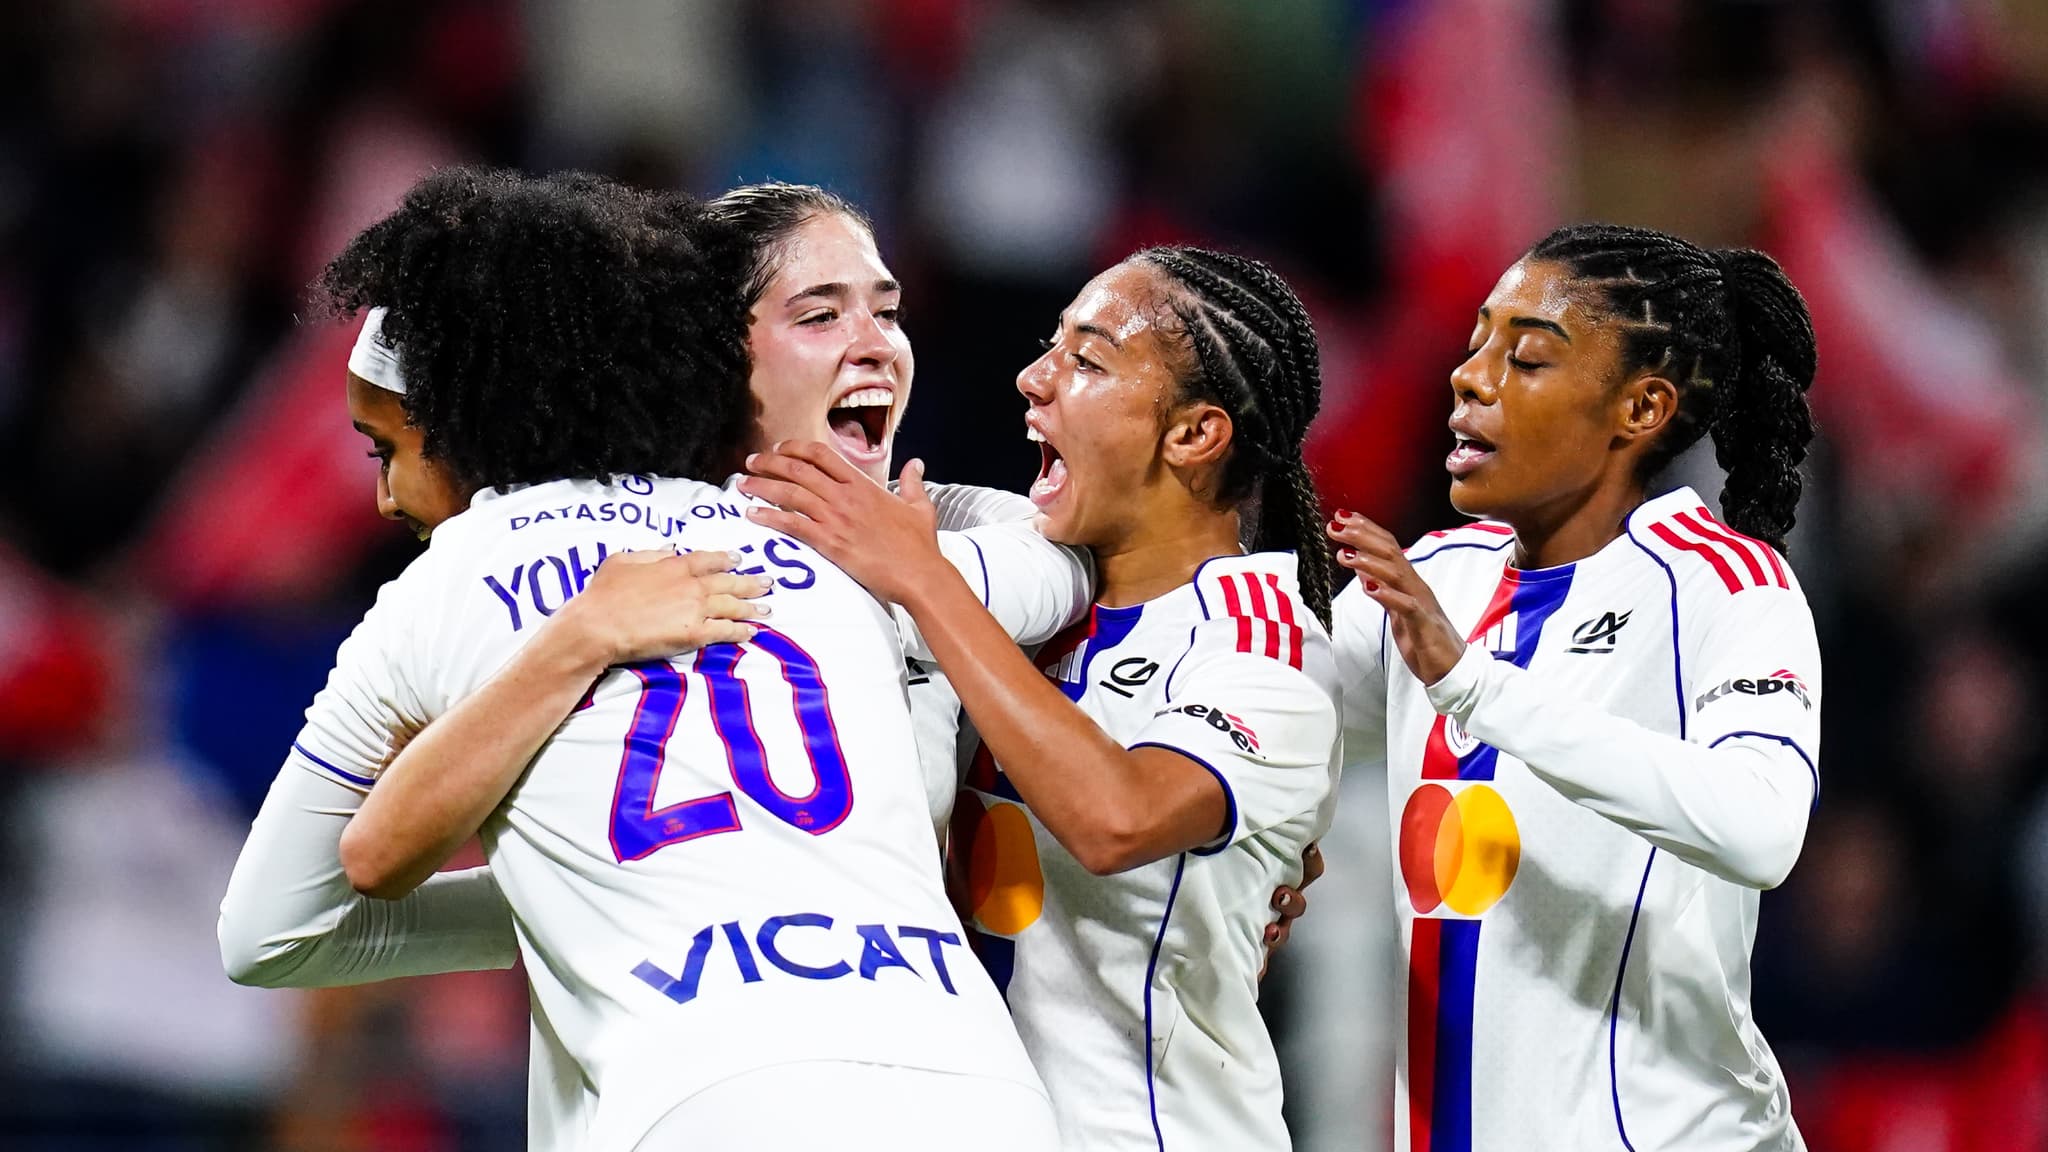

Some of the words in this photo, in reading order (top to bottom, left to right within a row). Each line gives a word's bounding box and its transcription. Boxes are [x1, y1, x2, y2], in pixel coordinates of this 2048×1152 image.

[510, 502, 741, 538] DATASOLUTON
[573, 620, 854, 864] 20
[630, 912, 962, 1005] VICAT
